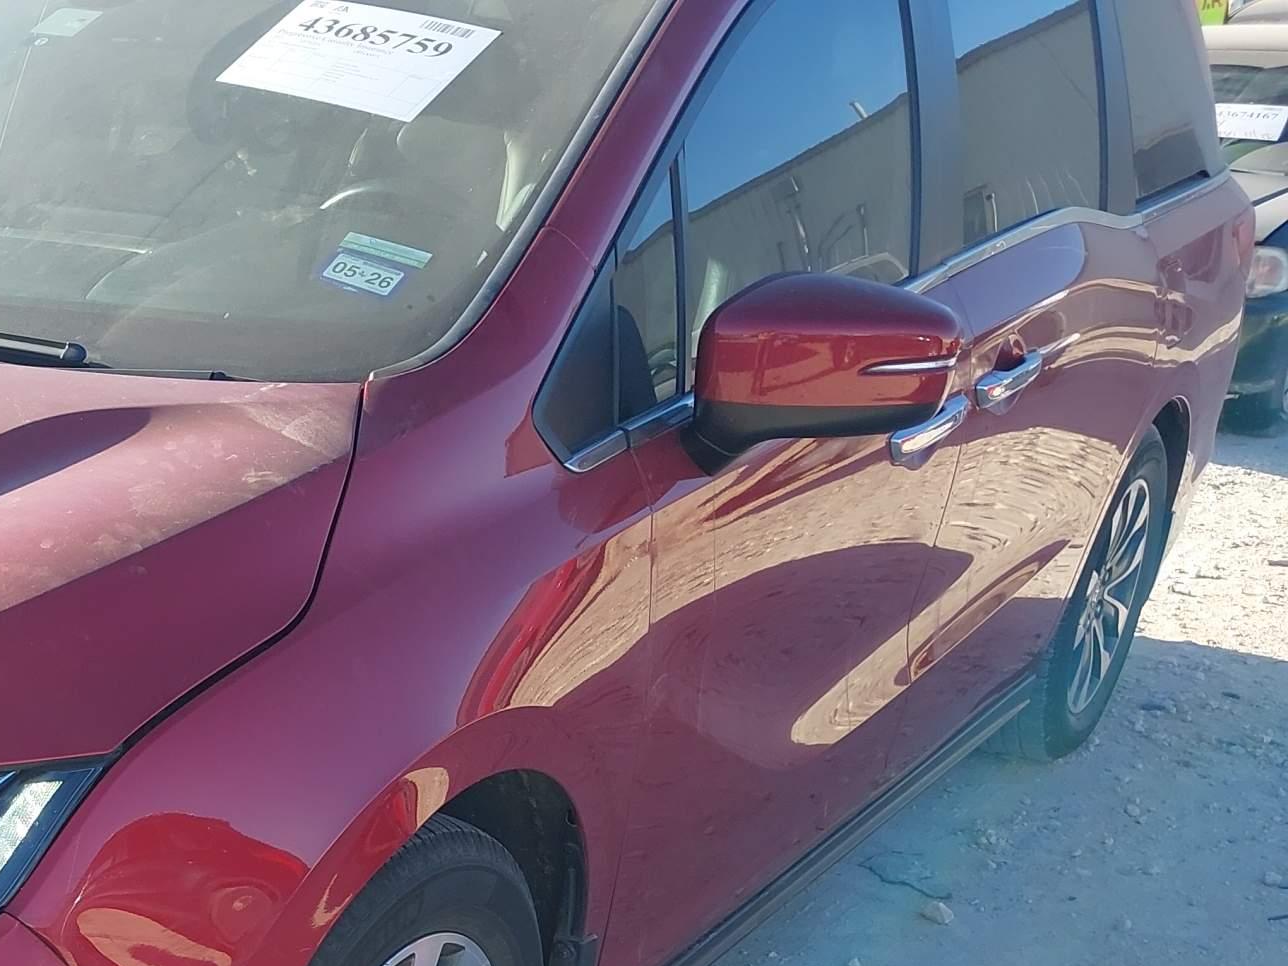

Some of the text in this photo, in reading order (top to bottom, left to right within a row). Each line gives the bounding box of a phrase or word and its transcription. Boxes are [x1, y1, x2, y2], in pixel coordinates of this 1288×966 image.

[298, 16, 454, 58] 43685759
[331, 261, 395, 289] 05 26
